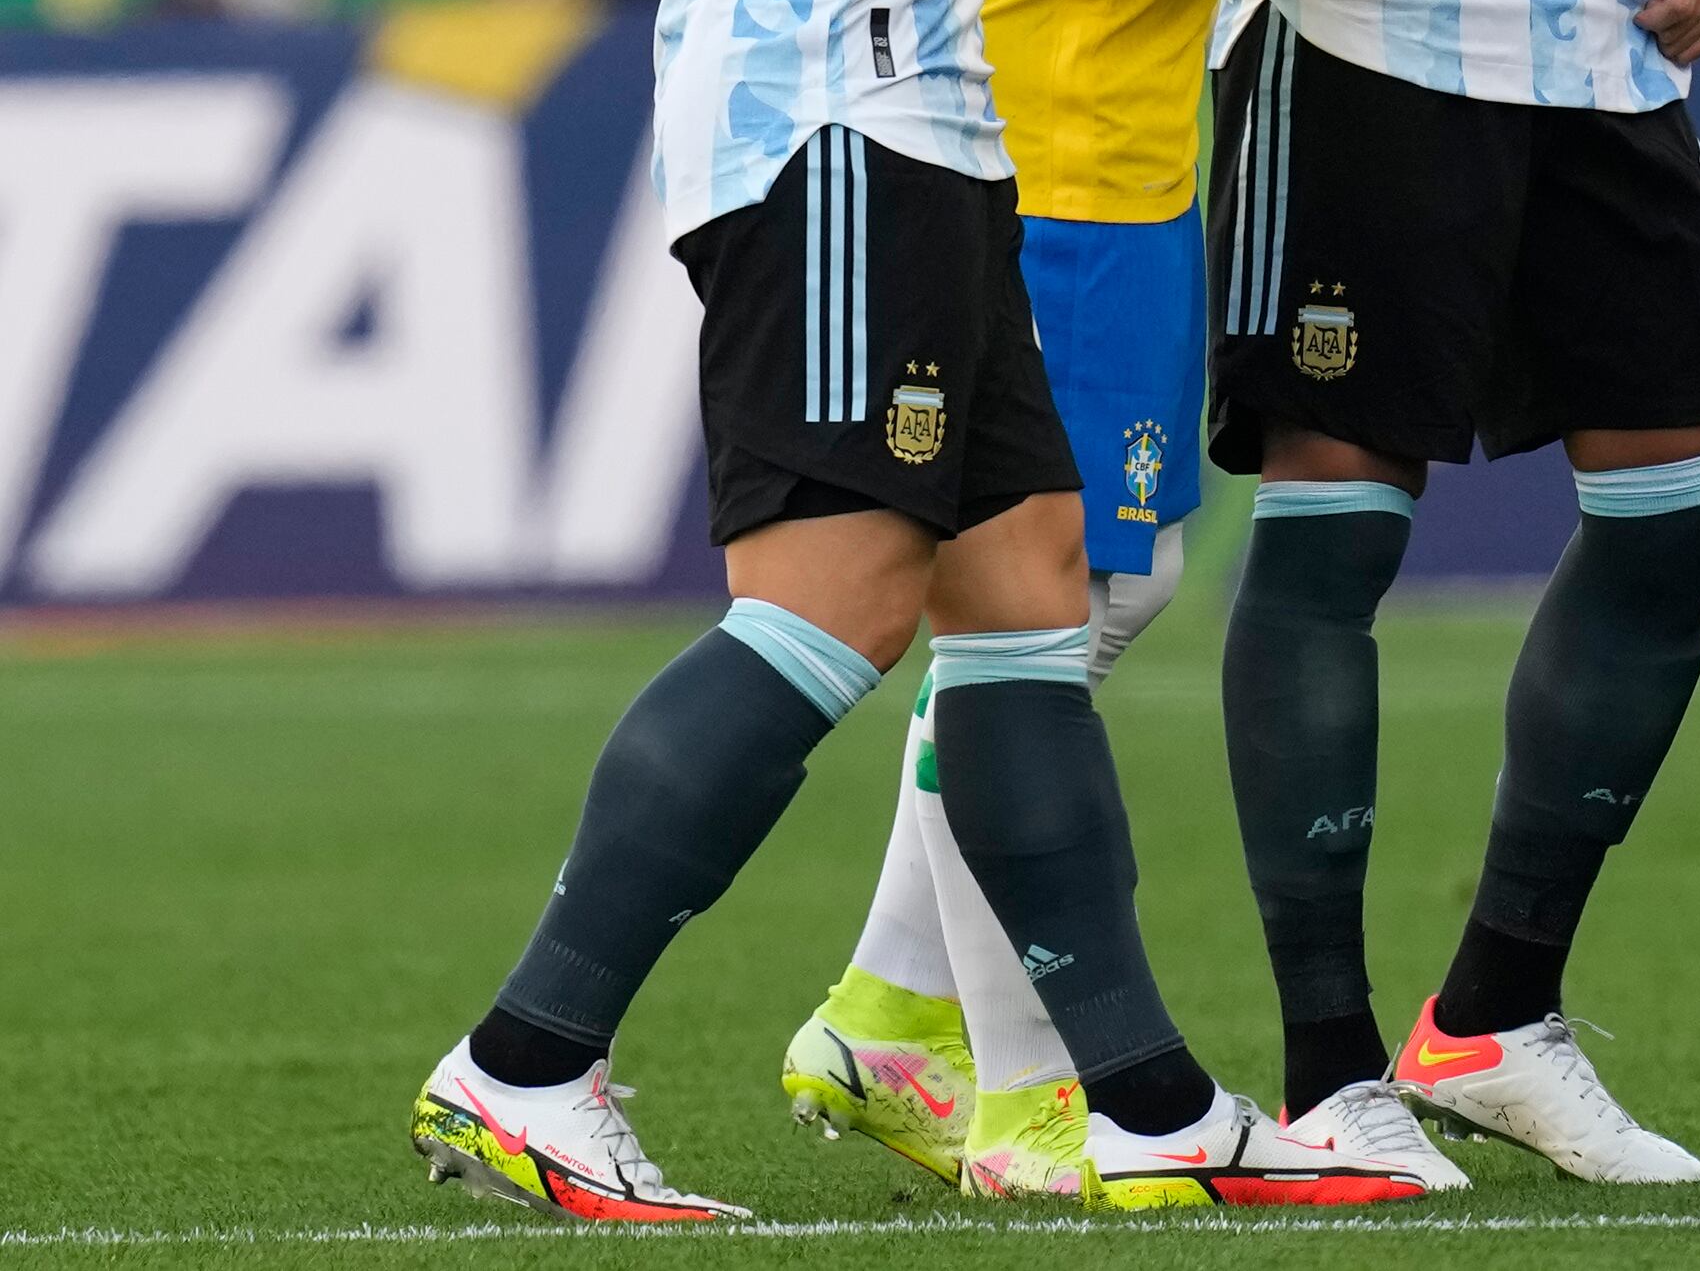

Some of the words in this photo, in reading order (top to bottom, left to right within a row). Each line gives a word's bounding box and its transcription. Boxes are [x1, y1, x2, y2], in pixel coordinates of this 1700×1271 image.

[1305, 324, 1342, 360] AFA
[899, 405, 932, 443] AFA
[1134, 462, 1151, 472] CBF
[1116, 506, 1158, 524] BRASIL
[1306, 806, 1375, 839] AFA
[544, 1144, 594, 1177] PHANTOM
